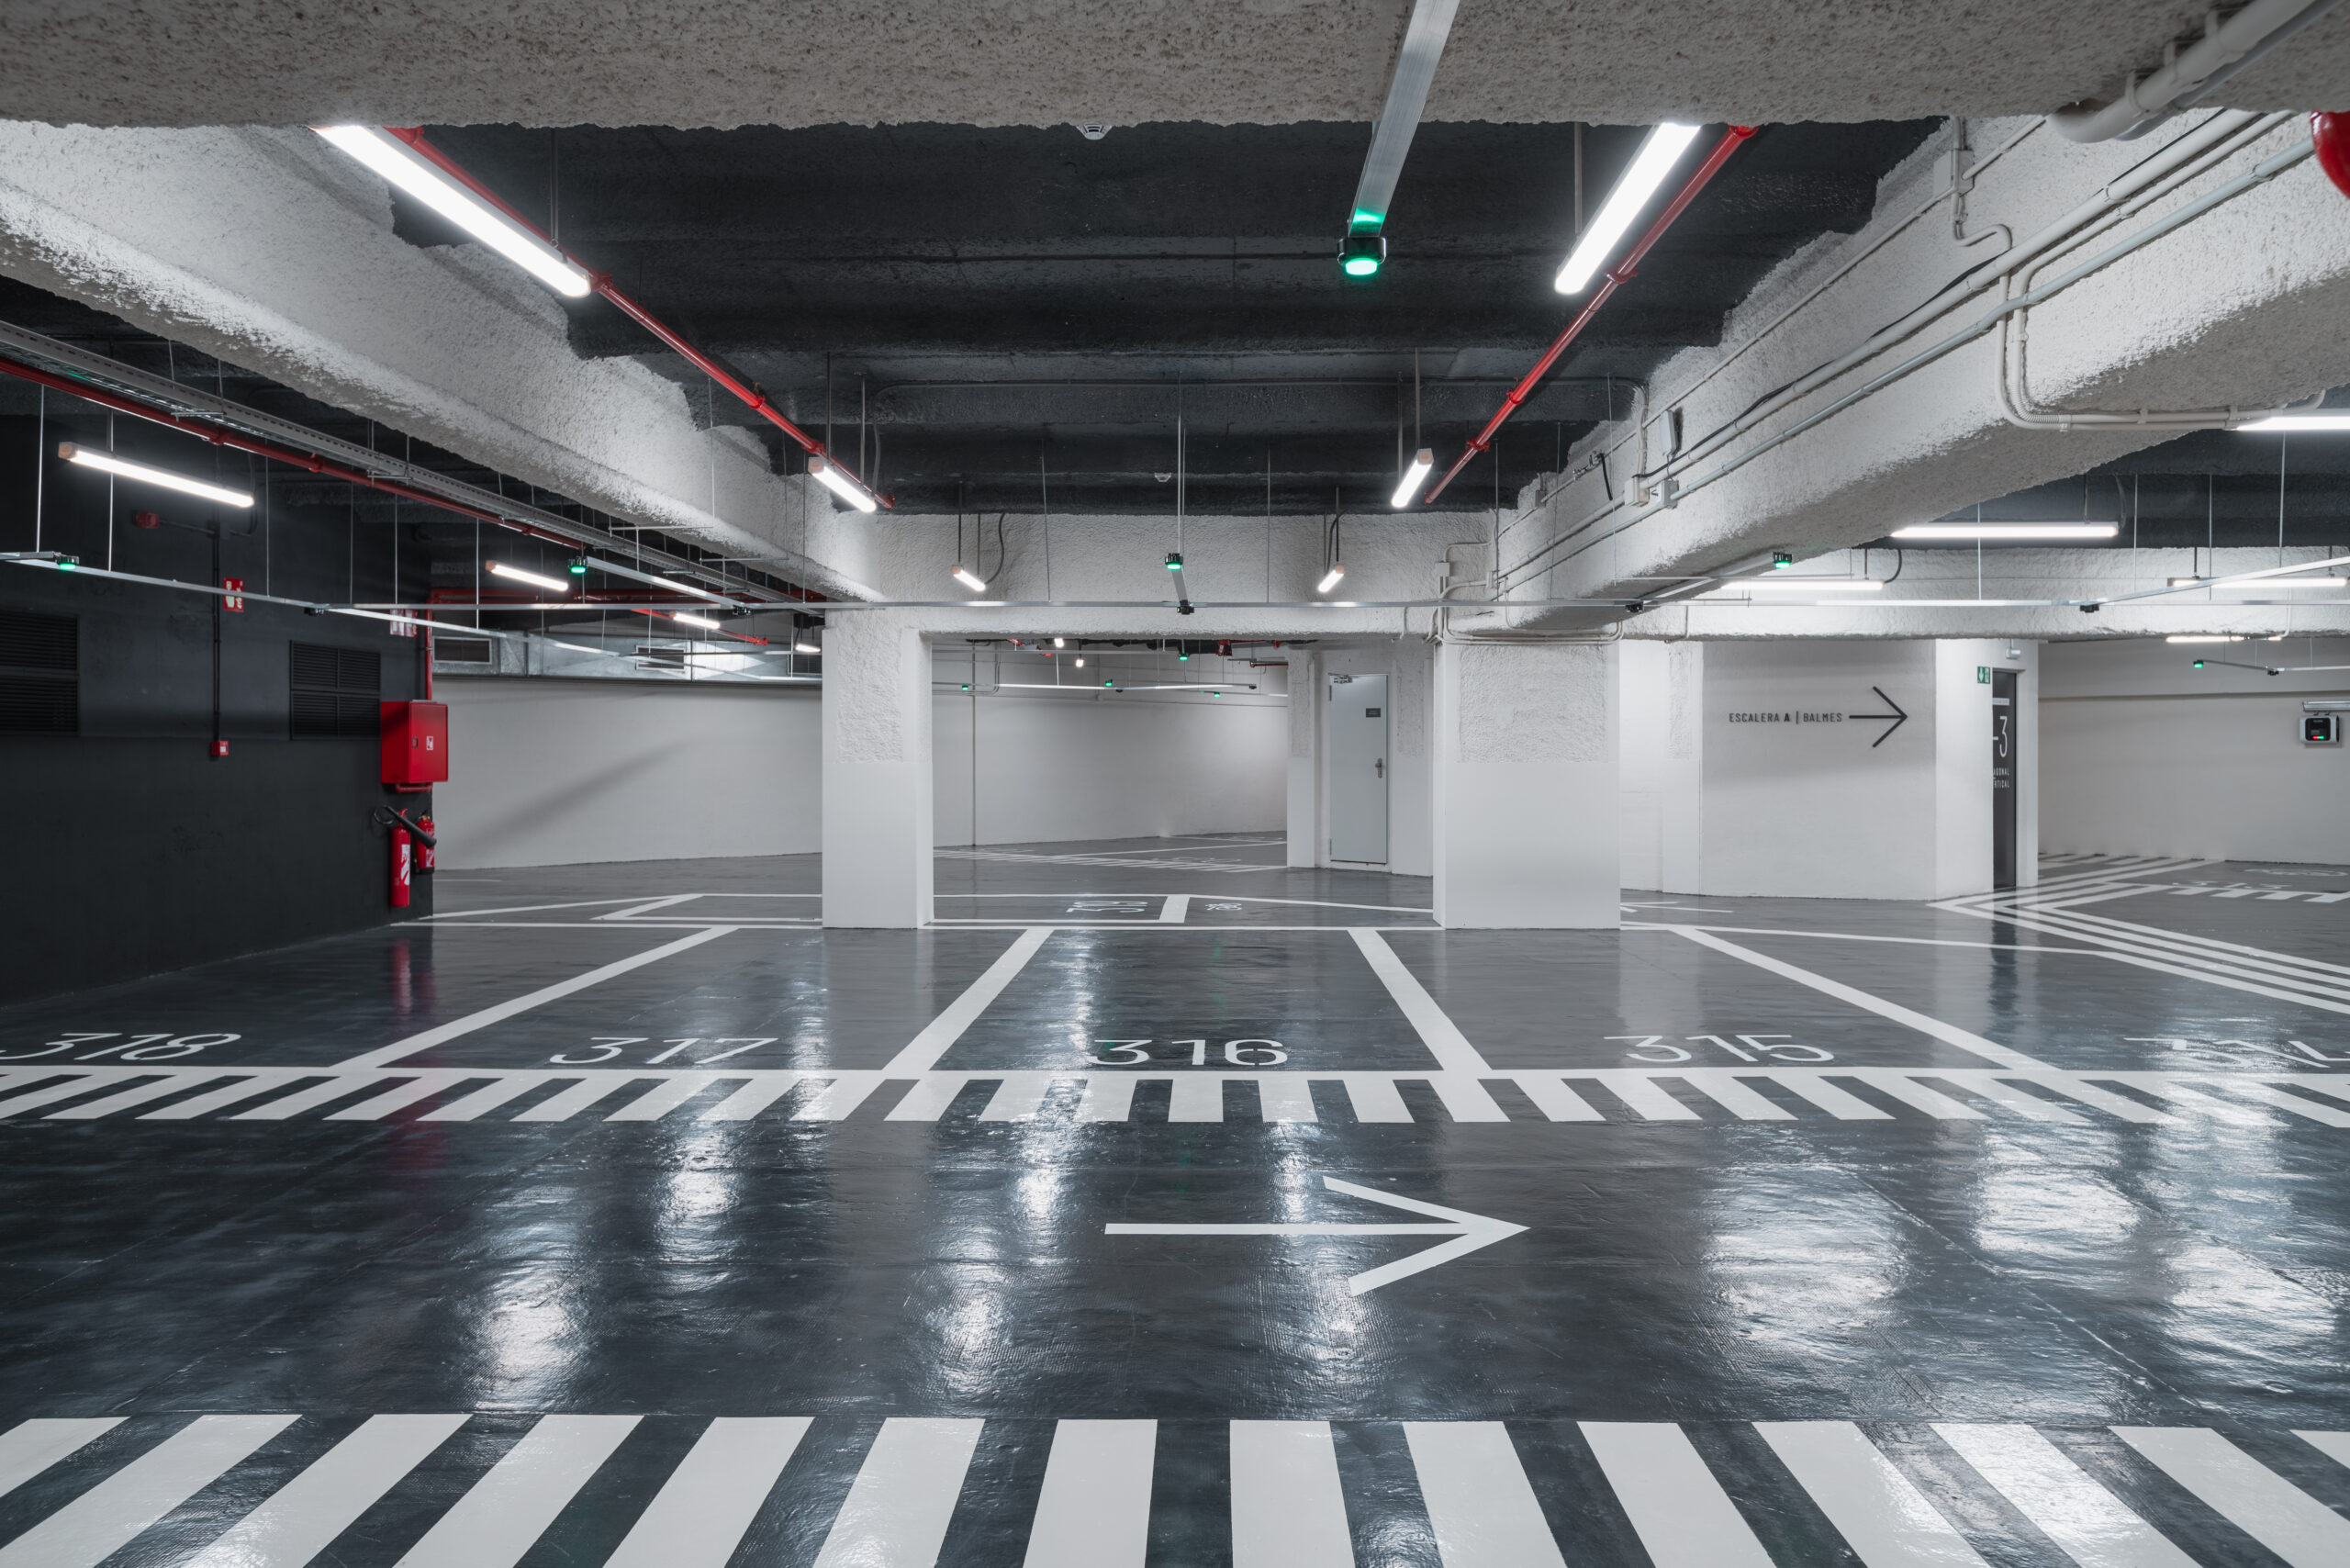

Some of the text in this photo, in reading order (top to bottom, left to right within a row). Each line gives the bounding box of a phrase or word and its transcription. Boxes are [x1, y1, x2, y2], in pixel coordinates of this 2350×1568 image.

[1729, 712, 1842, 722] ESCALERA A BALMES
[0, 1033, 241, 1060] 318
[549, 1037, 778, 1064] 317
[1087, 1039, 1288, 1066] 316
[1604, 1035, 1835, 1062] 315
